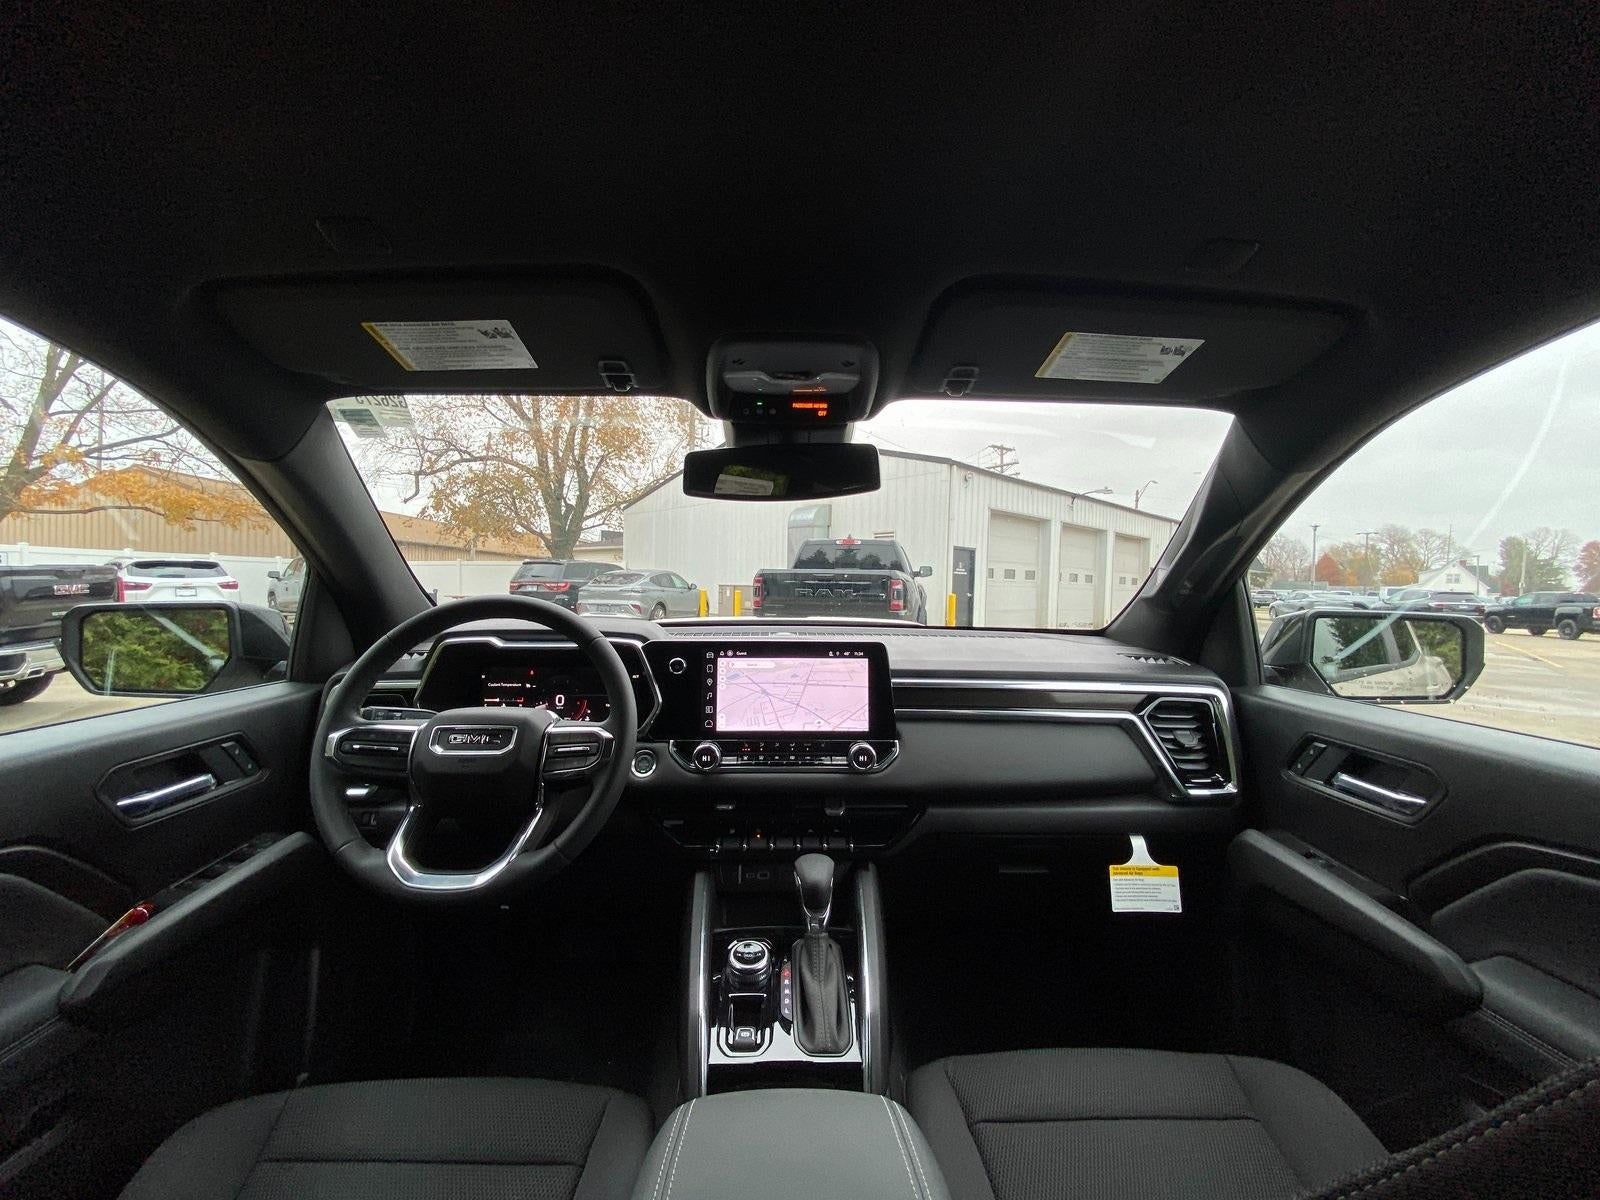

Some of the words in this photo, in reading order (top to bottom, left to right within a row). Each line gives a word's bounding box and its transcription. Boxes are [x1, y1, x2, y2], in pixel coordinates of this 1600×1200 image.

[53, 583, 91, 596] GMC
[555, 694, 565, 706] 0
[448, 734, 502, 745] GMC
